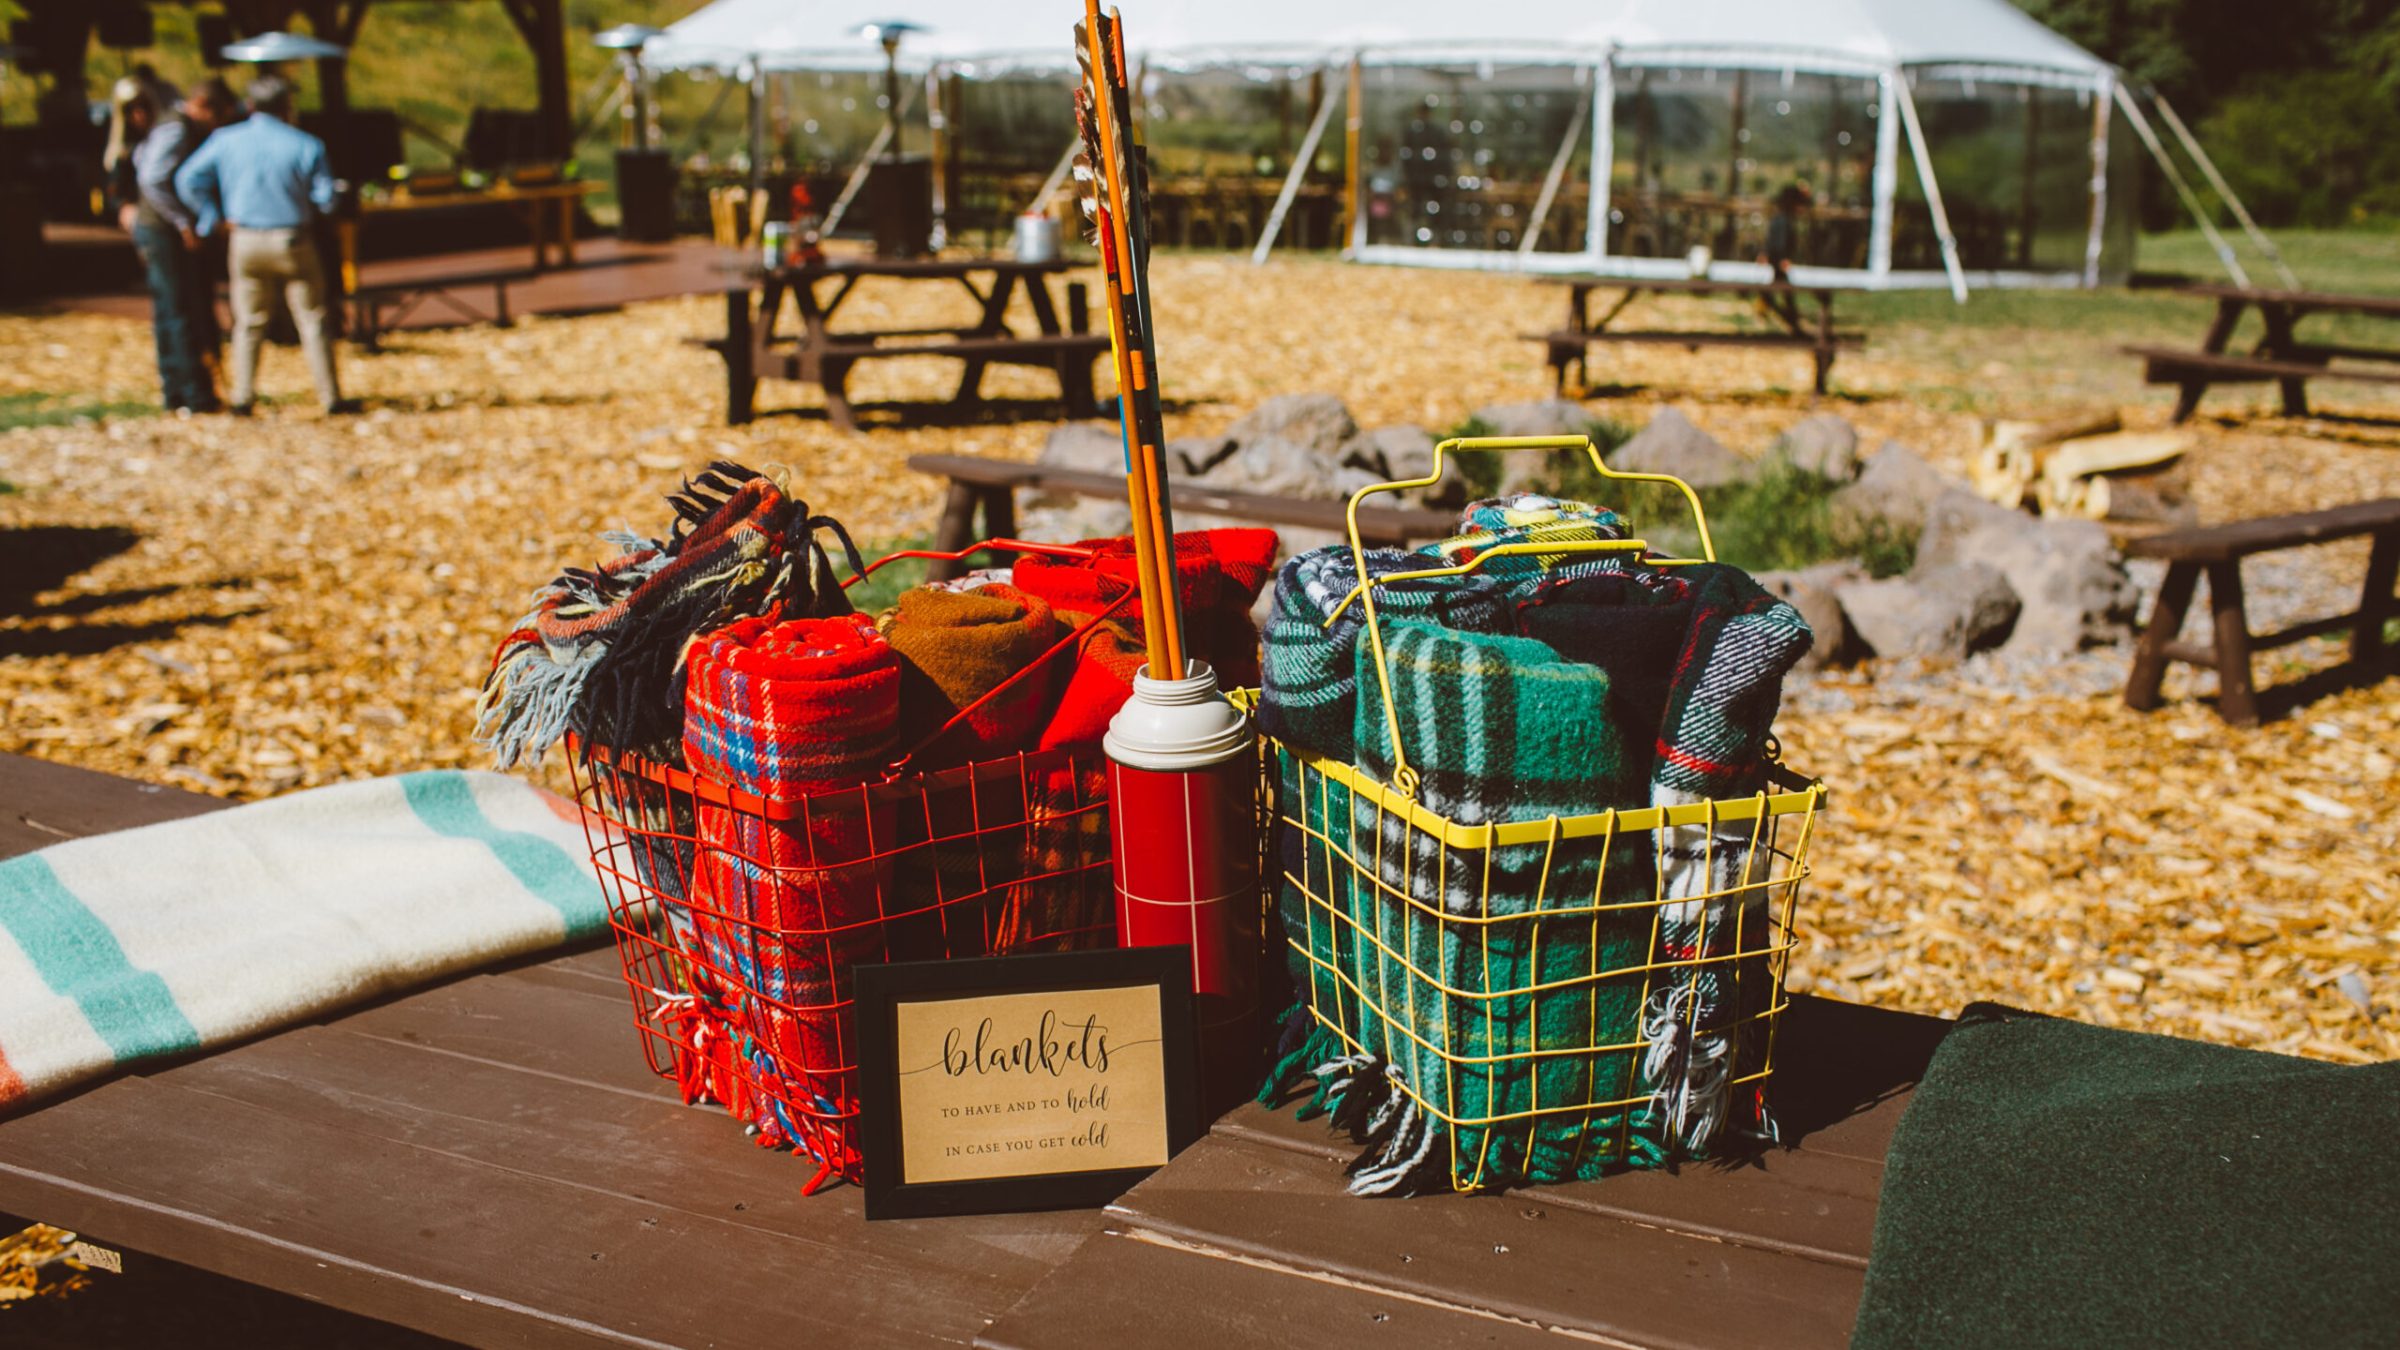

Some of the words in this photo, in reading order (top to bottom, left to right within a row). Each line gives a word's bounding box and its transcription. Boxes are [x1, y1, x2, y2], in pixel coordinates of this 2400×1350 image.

[943, 1009, 1109, 1077] blankets
[941, 1108, 960, 1118] TO
[965, 1104, 1001, 1116] HAVE
[1007, 1100, 1036, 1113] AND
[1041, 1099, 1060, 1109] TO
[1067, 1083, 1110, 1113] hold
[946, 1147, 961, 1157] IN
[966, 1143, 1001, 1155] CASE
[1005, 1140, 1034, 1152] YOU
[1039, 1137, 1066, 1148] GET
[1071, 1120, 1110, 1149] cold
